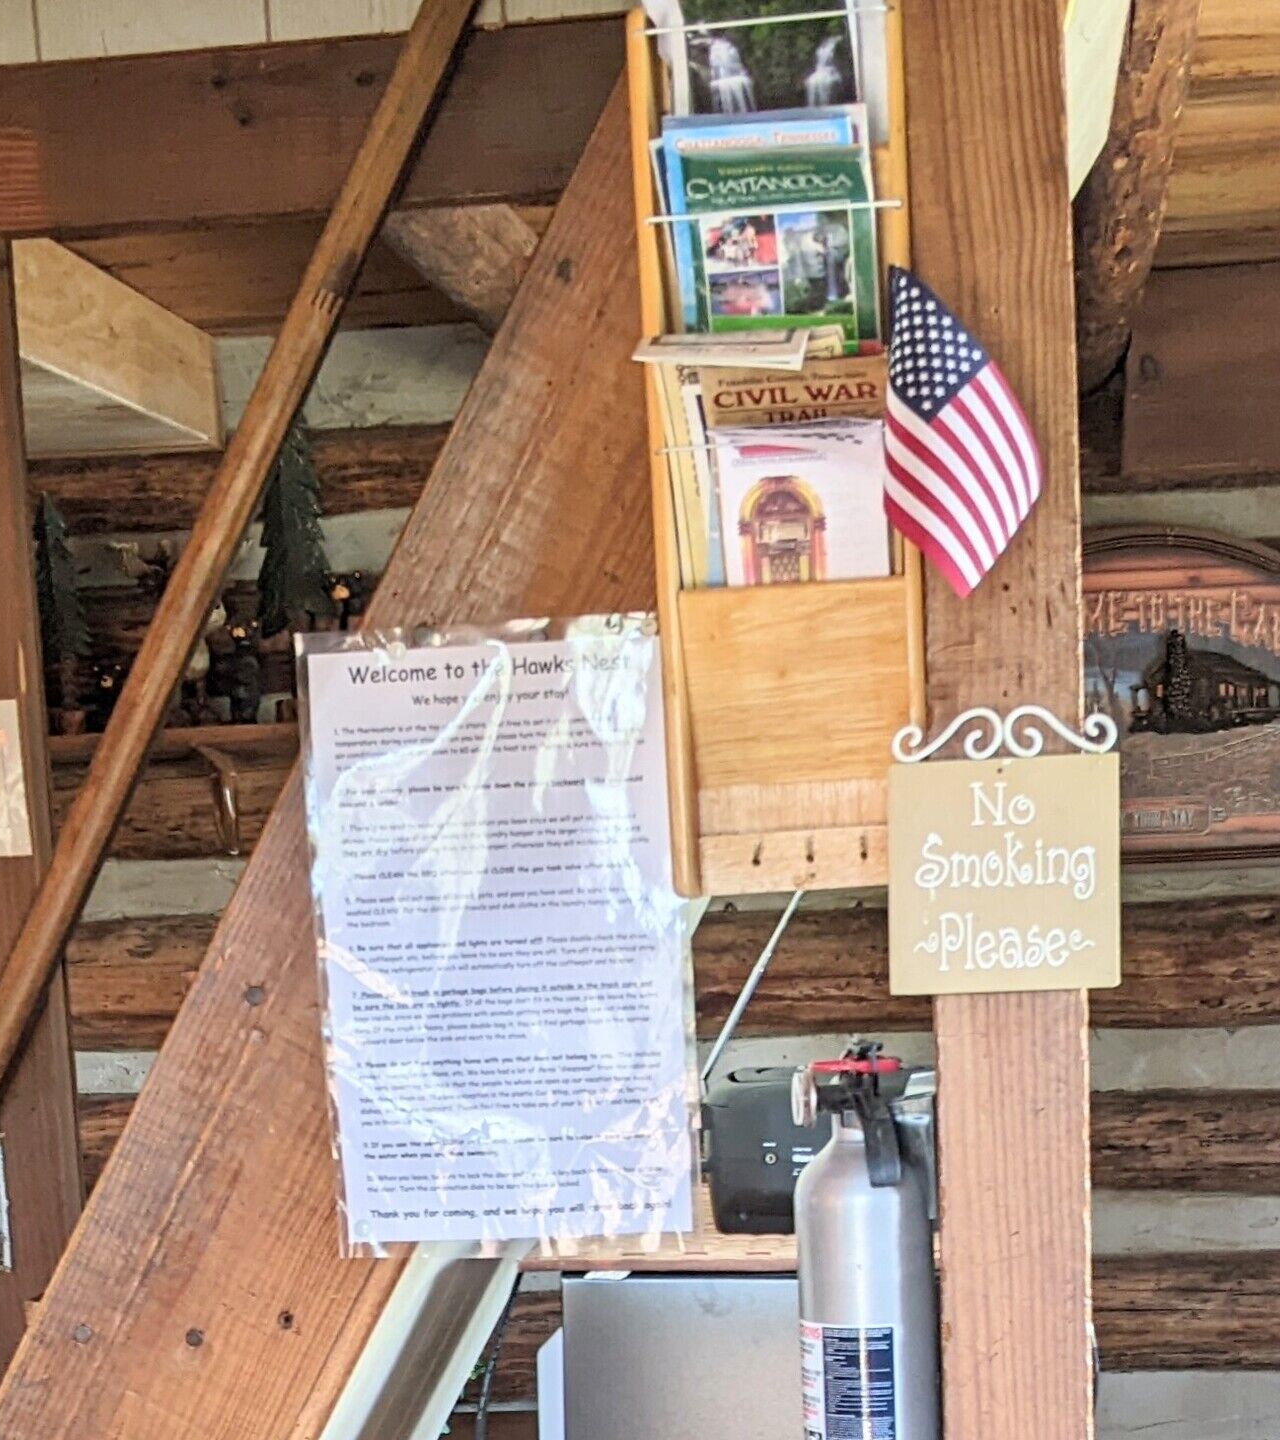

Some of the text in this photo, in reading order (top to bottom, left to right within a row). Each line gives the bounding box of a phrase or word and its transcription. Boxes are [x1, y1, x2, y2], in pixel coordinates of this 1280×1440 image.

[686, 173, 852, 199] CHATTANOOGA
[713, 381, 878, 409] CIVIL WAR
[1176, 595, 1222, 638] THE
[348, 665, 438, 684] Welcome
[444, 662, 465, 680] to
[512, 654, 573, 676] Hawks
[412, 695, 430, 706] We
[433, 693, 458, 706] hope
[517, 689, 540, 703] your
[970, 781, 1035, 827] No
[914, 831, 1097, 901] Smoking
[938, 911, 1069, 972] Please
[370, 1210, 399, 1219] Thank
[403, 1210, 420, 1221] you
[423, 1208, 439, 1218] for
[483, 1207, 500, 1216] and
